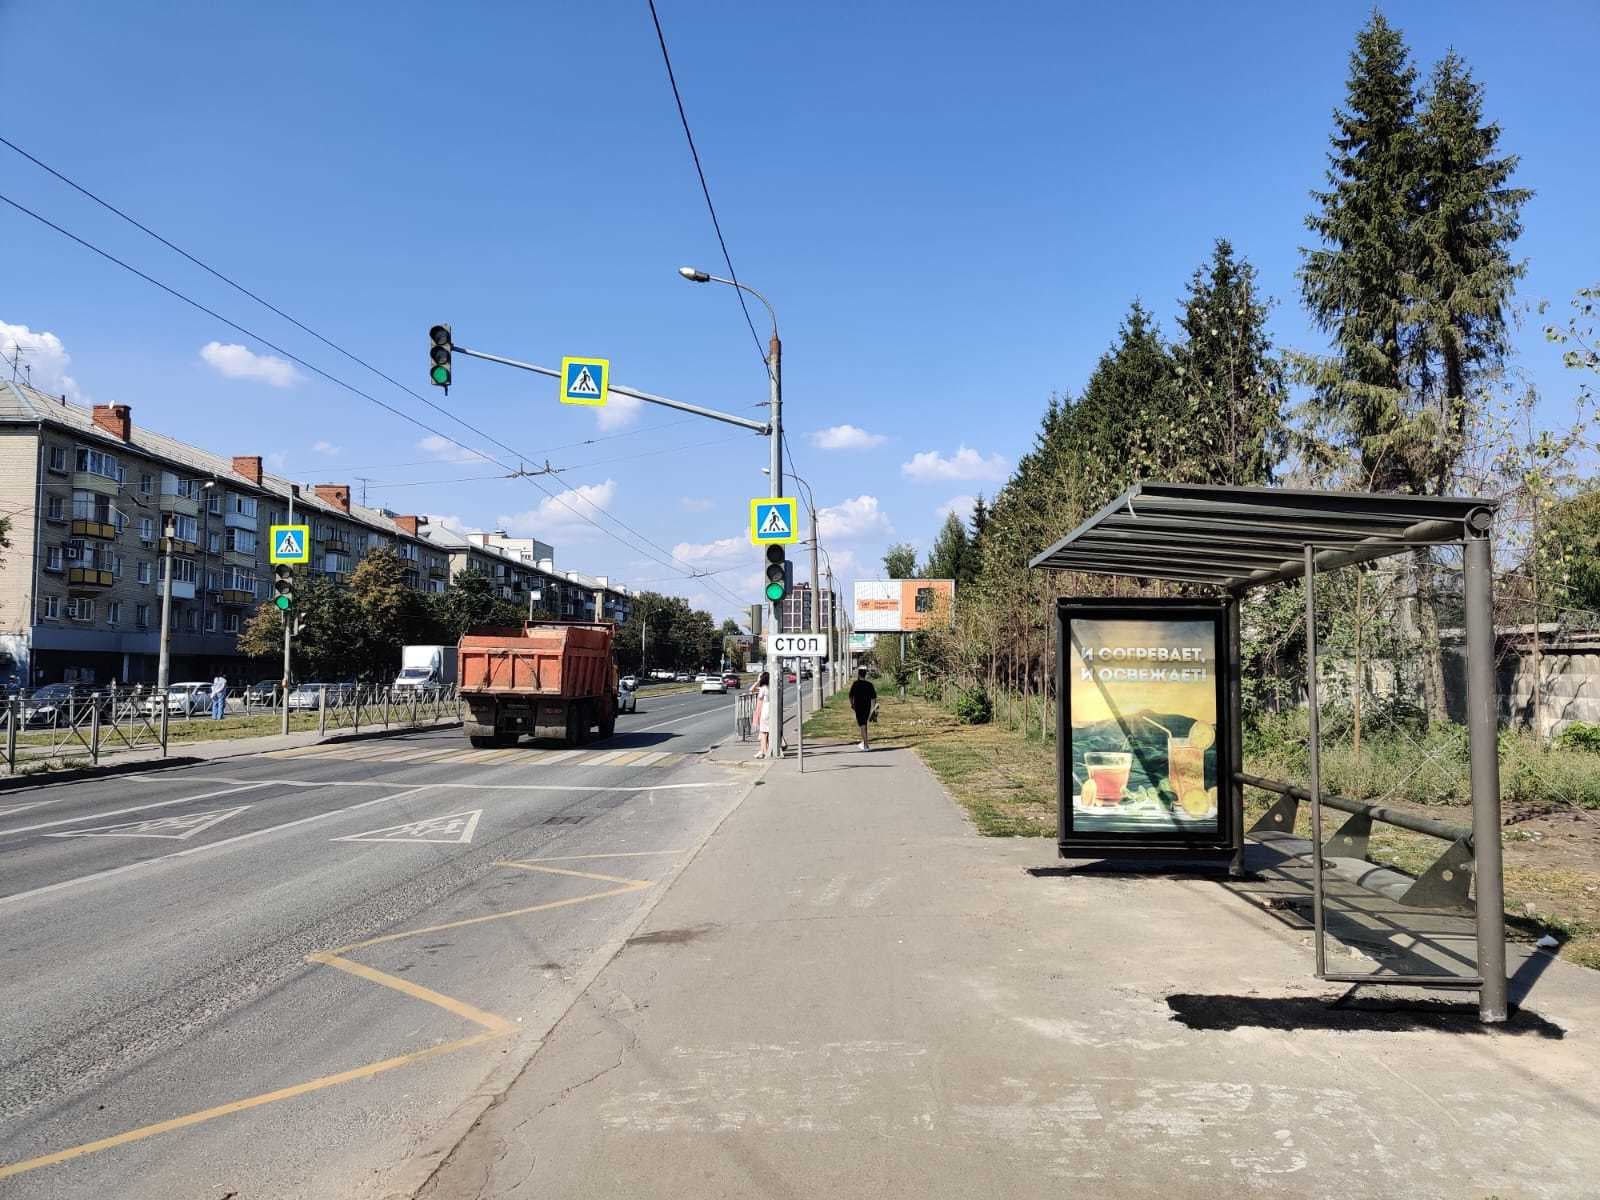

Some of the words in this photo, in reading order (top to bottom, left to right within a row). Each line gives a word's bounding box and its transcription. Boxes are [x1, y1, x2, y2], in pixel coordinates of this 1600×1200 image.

[775, 637, 818, 651] СТОП
[1081, 647, 1093, 661] И
[1099, 647, 1206, 662] СОГРЕВАЕТ,
[1080, 668, 1093, 681] И
[1099, 668, 1207, 682] ОСВЕЖАЕТ!
